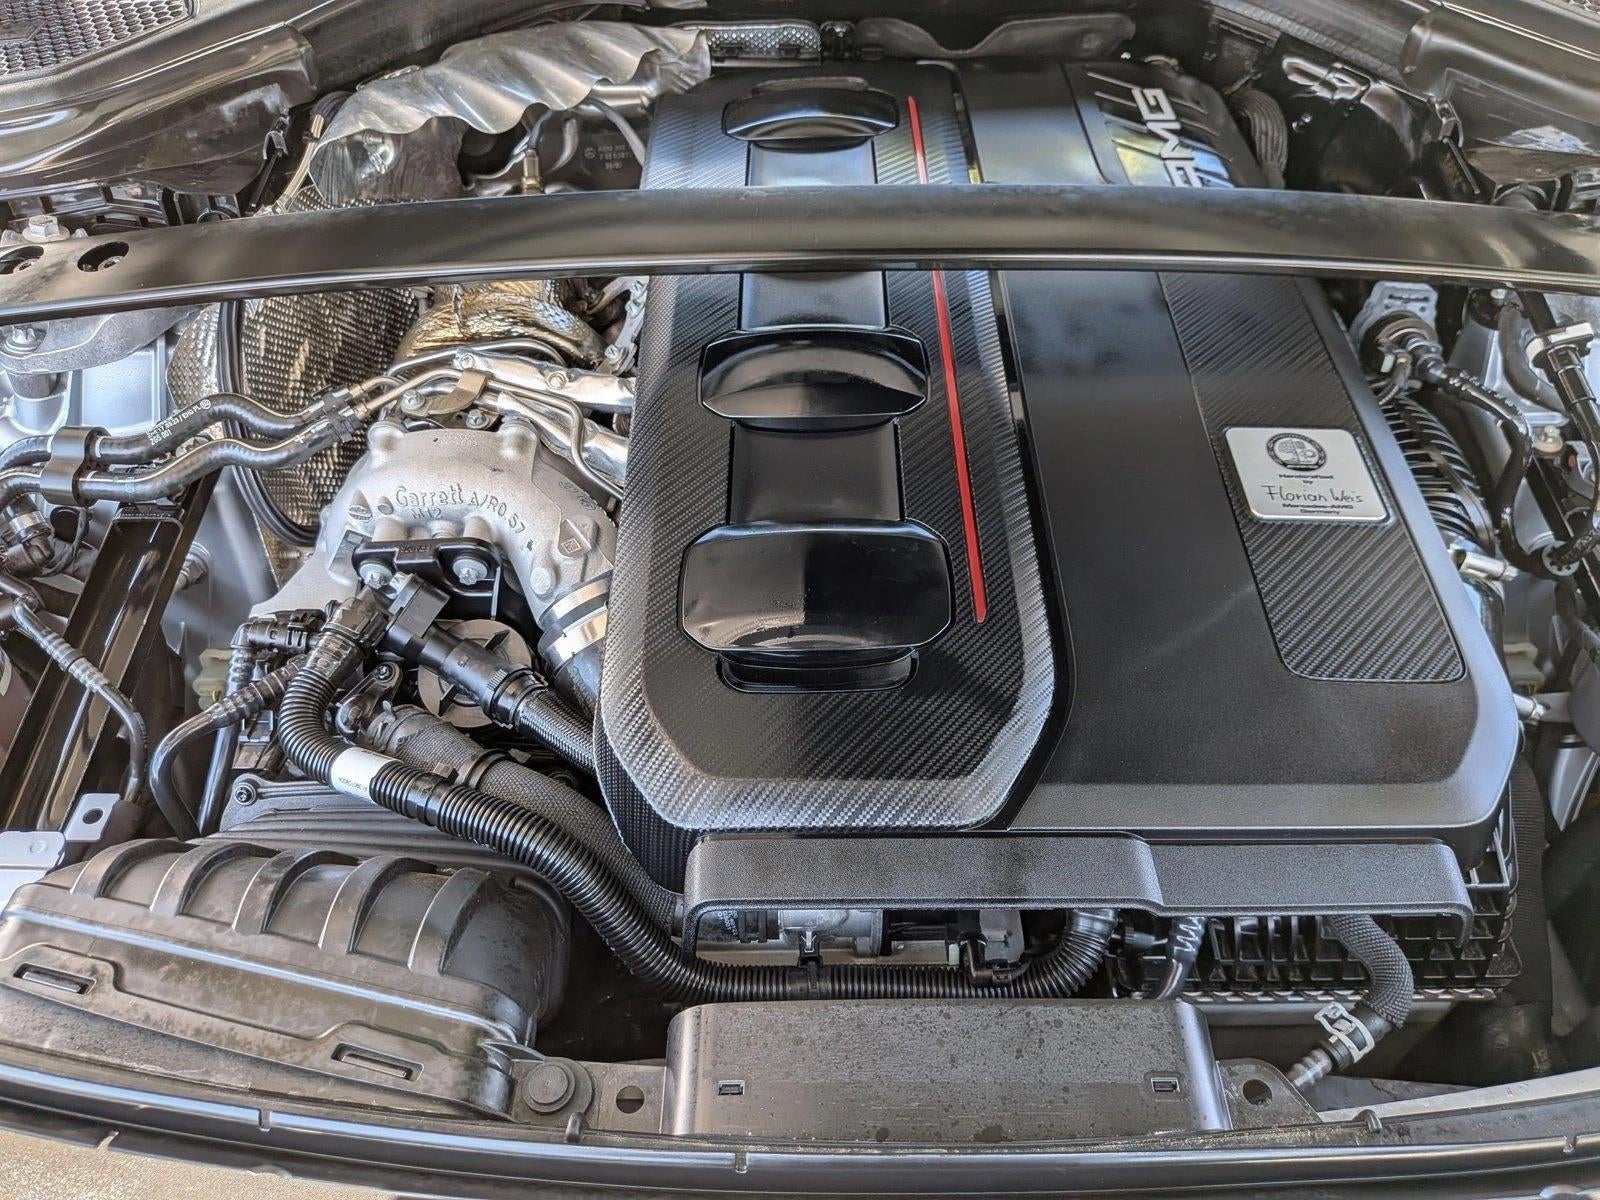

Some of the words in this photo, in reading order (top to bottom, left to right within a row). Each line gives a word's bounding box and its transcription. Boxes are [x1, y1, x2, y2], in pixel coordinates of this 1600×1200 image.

[396, 483, 464, 508] Garrett
[1261, 485, 1327, 502] Florian
[1330, 488, 1364, 503] Weis
